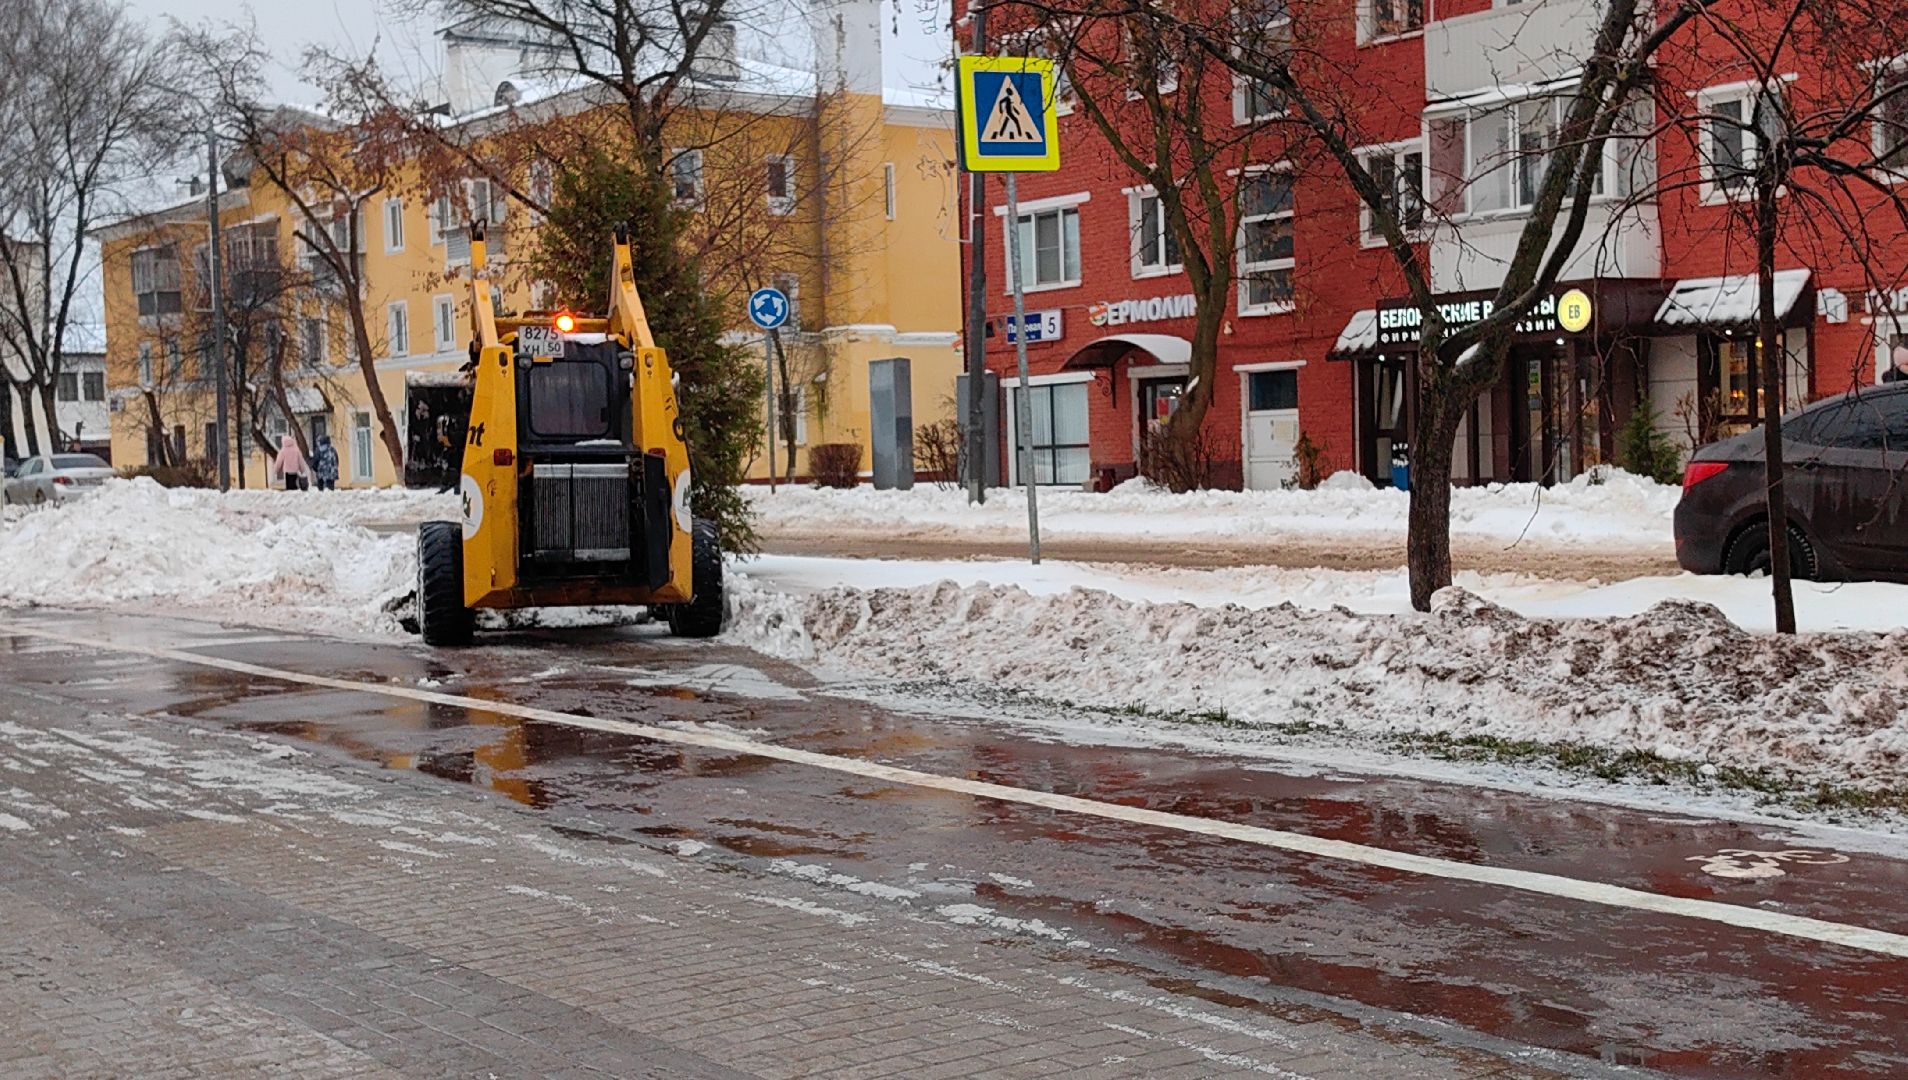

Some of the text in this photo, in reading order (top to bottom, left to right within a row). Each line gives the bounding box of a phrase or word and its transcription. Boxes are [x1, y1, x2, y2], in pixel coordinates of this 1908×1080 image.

[1380, 302, 1481, 329] БЕЛОСКИЕ
[525, 326, 559, 340] 8275
[1008, 316, 1056, 335] Паовая 5
[547, 342, 561, 352] 50
